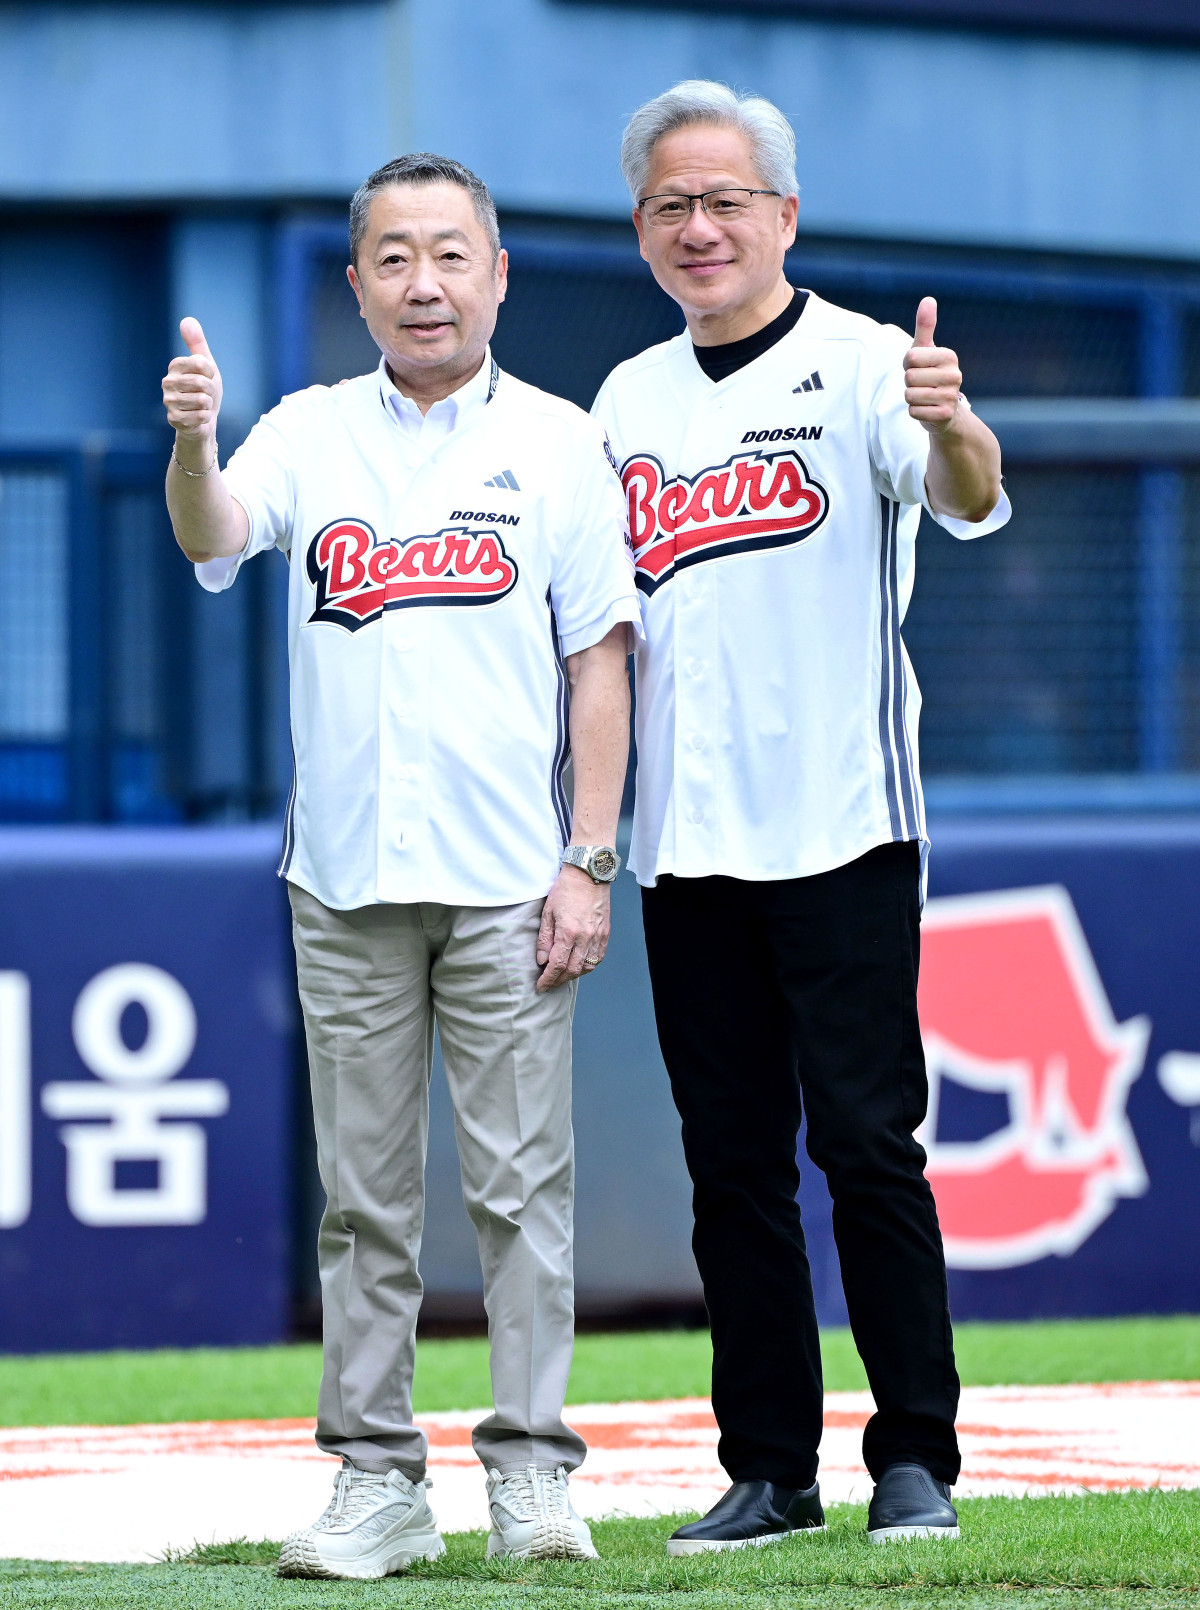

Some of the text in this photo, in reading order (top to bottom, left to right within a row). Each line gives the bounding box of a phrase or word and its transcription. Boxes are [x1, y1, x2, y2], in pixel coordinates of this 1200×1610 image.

[740, 426, 823, 444] DOOSAN
[449, 510, 520, 527] DOOSAN
[621, 460, 822, 548] Bears
[318, 524, 513, 595] Bears
